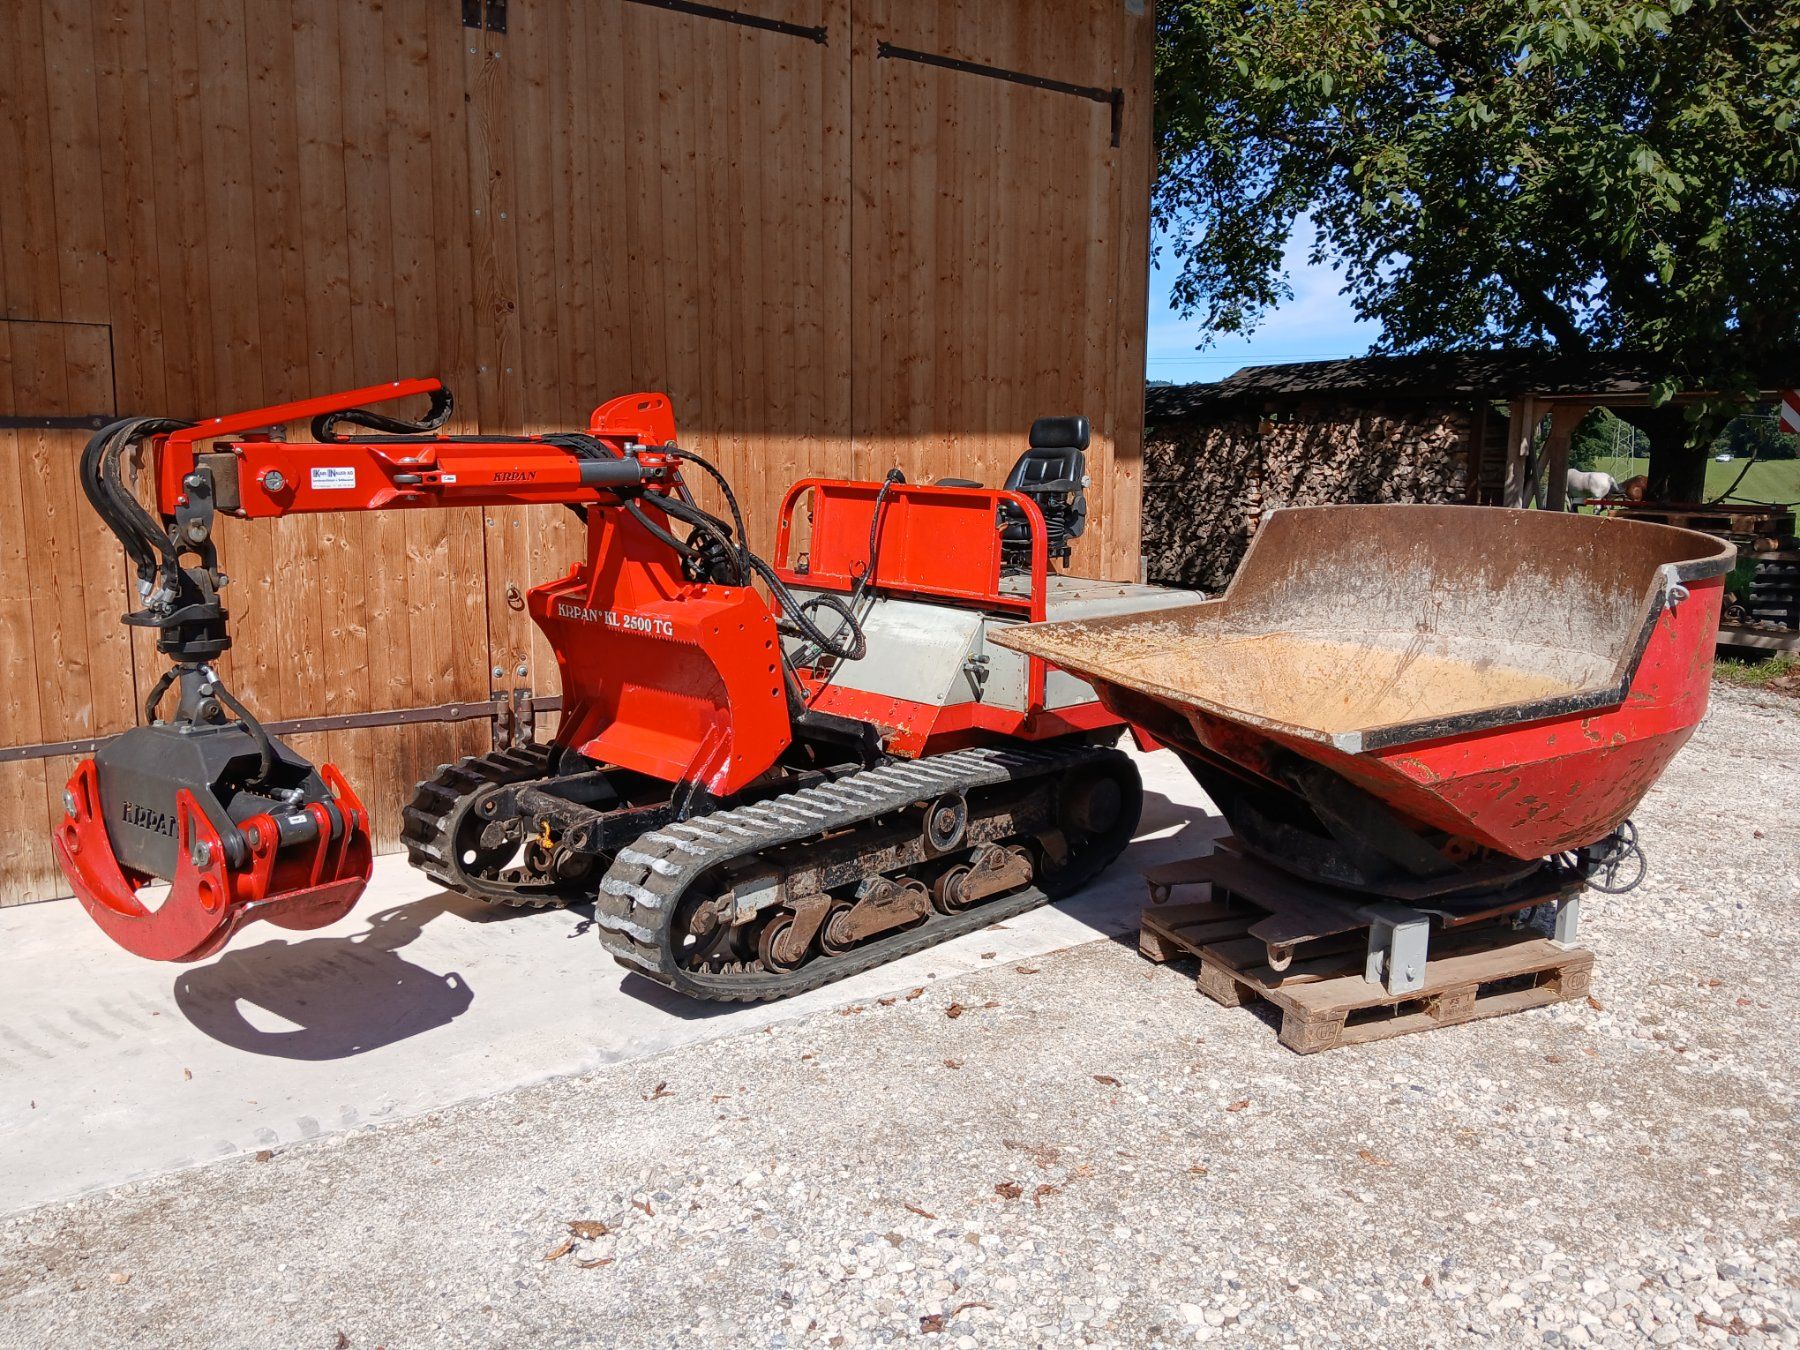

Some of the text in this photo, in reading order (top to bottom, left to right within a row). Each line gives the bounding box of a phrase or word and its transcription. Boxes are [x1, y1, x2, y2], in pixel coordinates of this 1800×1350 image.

[493, 471, 537, 482] KRPAN
[604, 610, 621, 627] KL
[623, 614, 652, 633] 2500
[653, 619, 674, 636] TG
